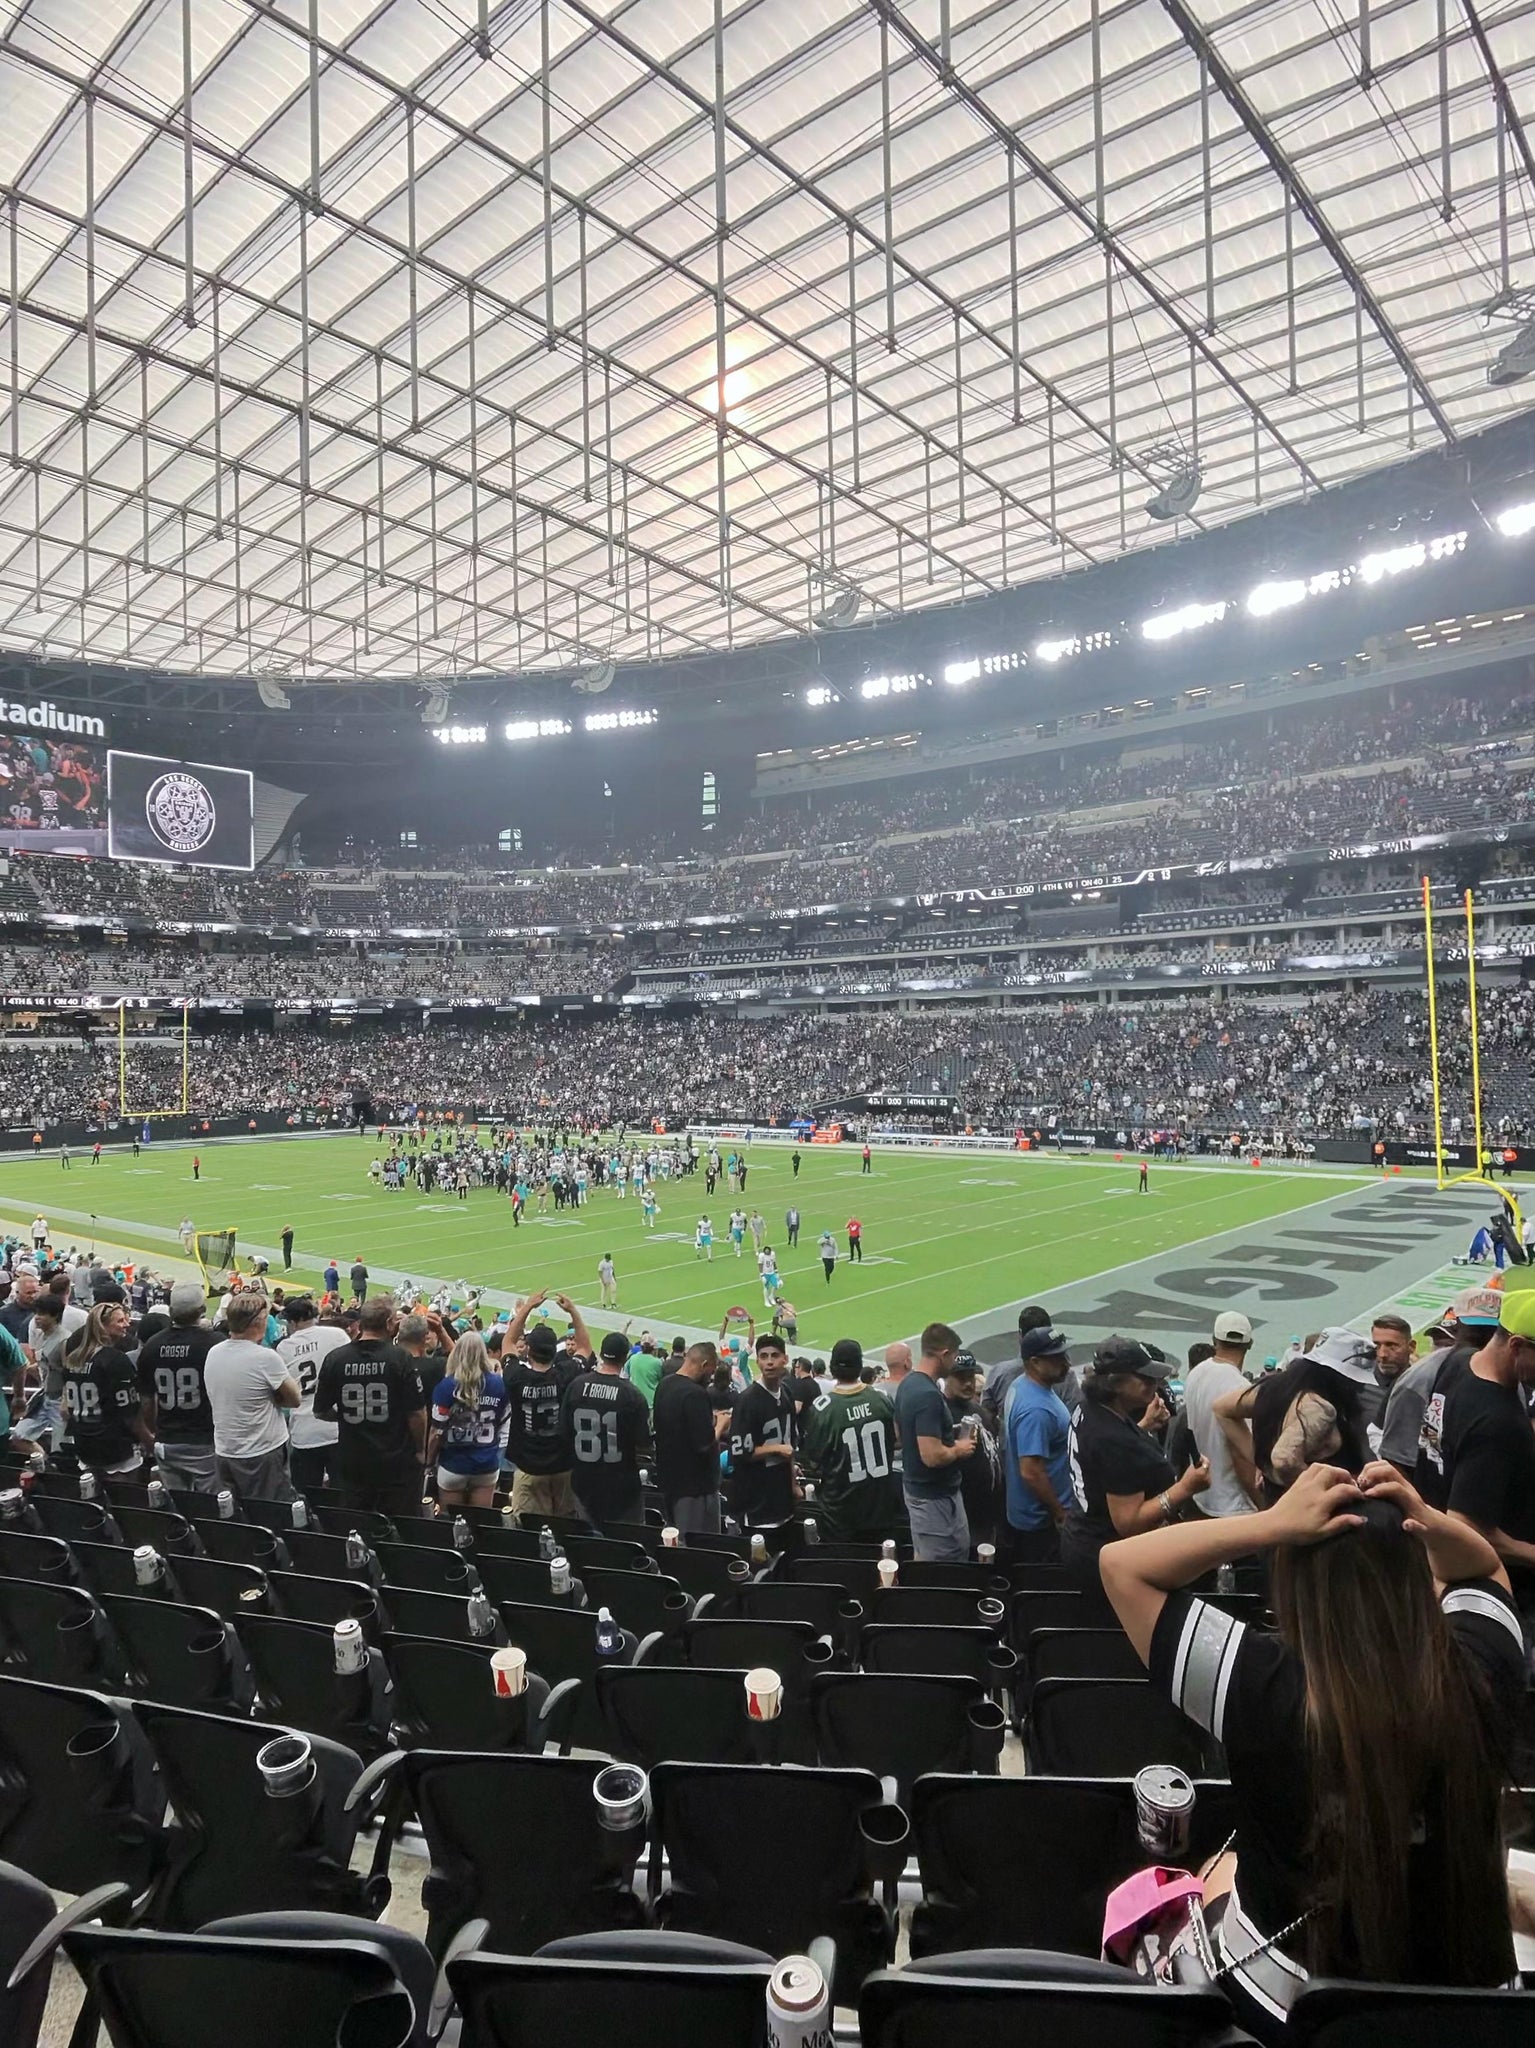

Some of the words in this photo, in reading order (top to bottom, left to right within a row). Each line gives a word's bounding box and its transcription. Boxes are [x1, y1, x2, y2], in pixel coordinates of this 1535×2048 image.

[1329, 845, 1380, 861] RAIDS
[1016, 885, 1035, 895] 0:00
[1042, 883, 1057, 892] 4TH
[1081, 879, 1093, 887] ON
[1093, 878, 1103, 886] 40
[1112, 876, 1123, 884] 25
[1201, 962, 1249, 976] RAIDS
[940, 1098, 948, 1106] 25
[160, 1345, 191, 1358] CROSBY
[294, 1342, 319, 1358] JEANTY
[298, 1360, 318, 1396] 2
[344, 1361, 387, 1376] CROSBY
[154, 1367, 202, 1411] 98
[522, 1385, 558, 1399] RENFROW
[589, 1383, 619, 1401] BROWN
[341, 1382, 390, 1424] 98
[846, 1402, 872, 1421] LOVE
[522, 1402, 560, 1438] 13
[573, 1407, 623, 1463] 81
[731, 1432, 754, 1456] 24
[842, 1419, 889, 1483] 10
